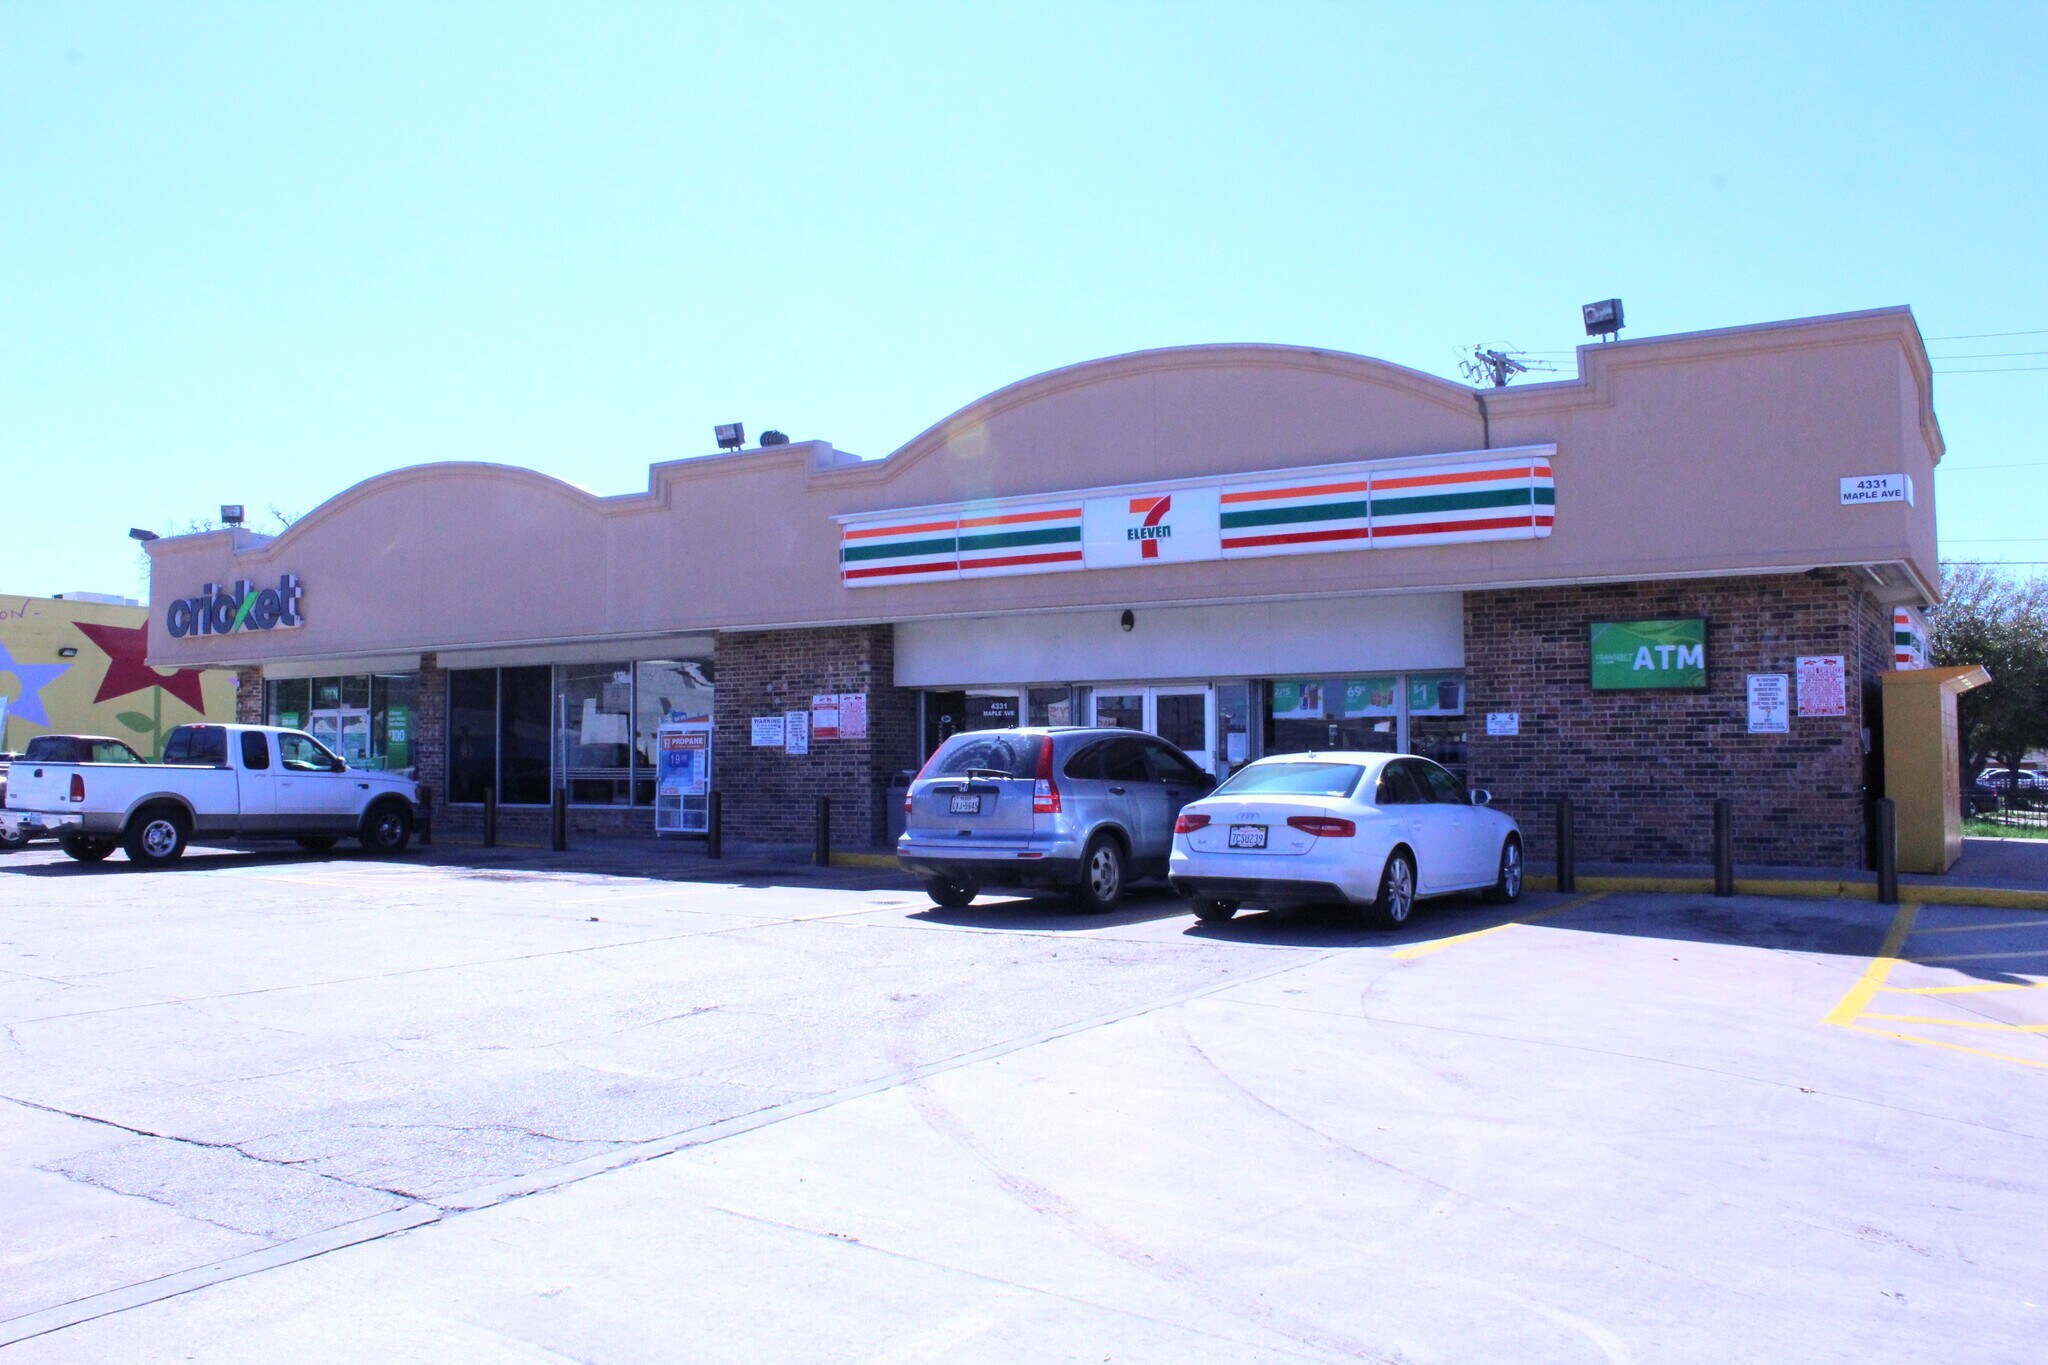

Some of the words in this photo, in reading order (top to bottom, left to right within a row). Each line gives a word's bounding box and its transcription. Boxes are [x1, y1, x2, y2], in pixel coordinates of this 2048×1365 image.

[1857, 479, 1887, 489] 4331
[1843, 491, 1878, 501] MAPLE
[1881, 489, 1902, 498] AVE
[166, 574, 302, 638] cricket
[1632, 643, 1705, 671] ATM
[671, 737, 704, 746] PROPANE
